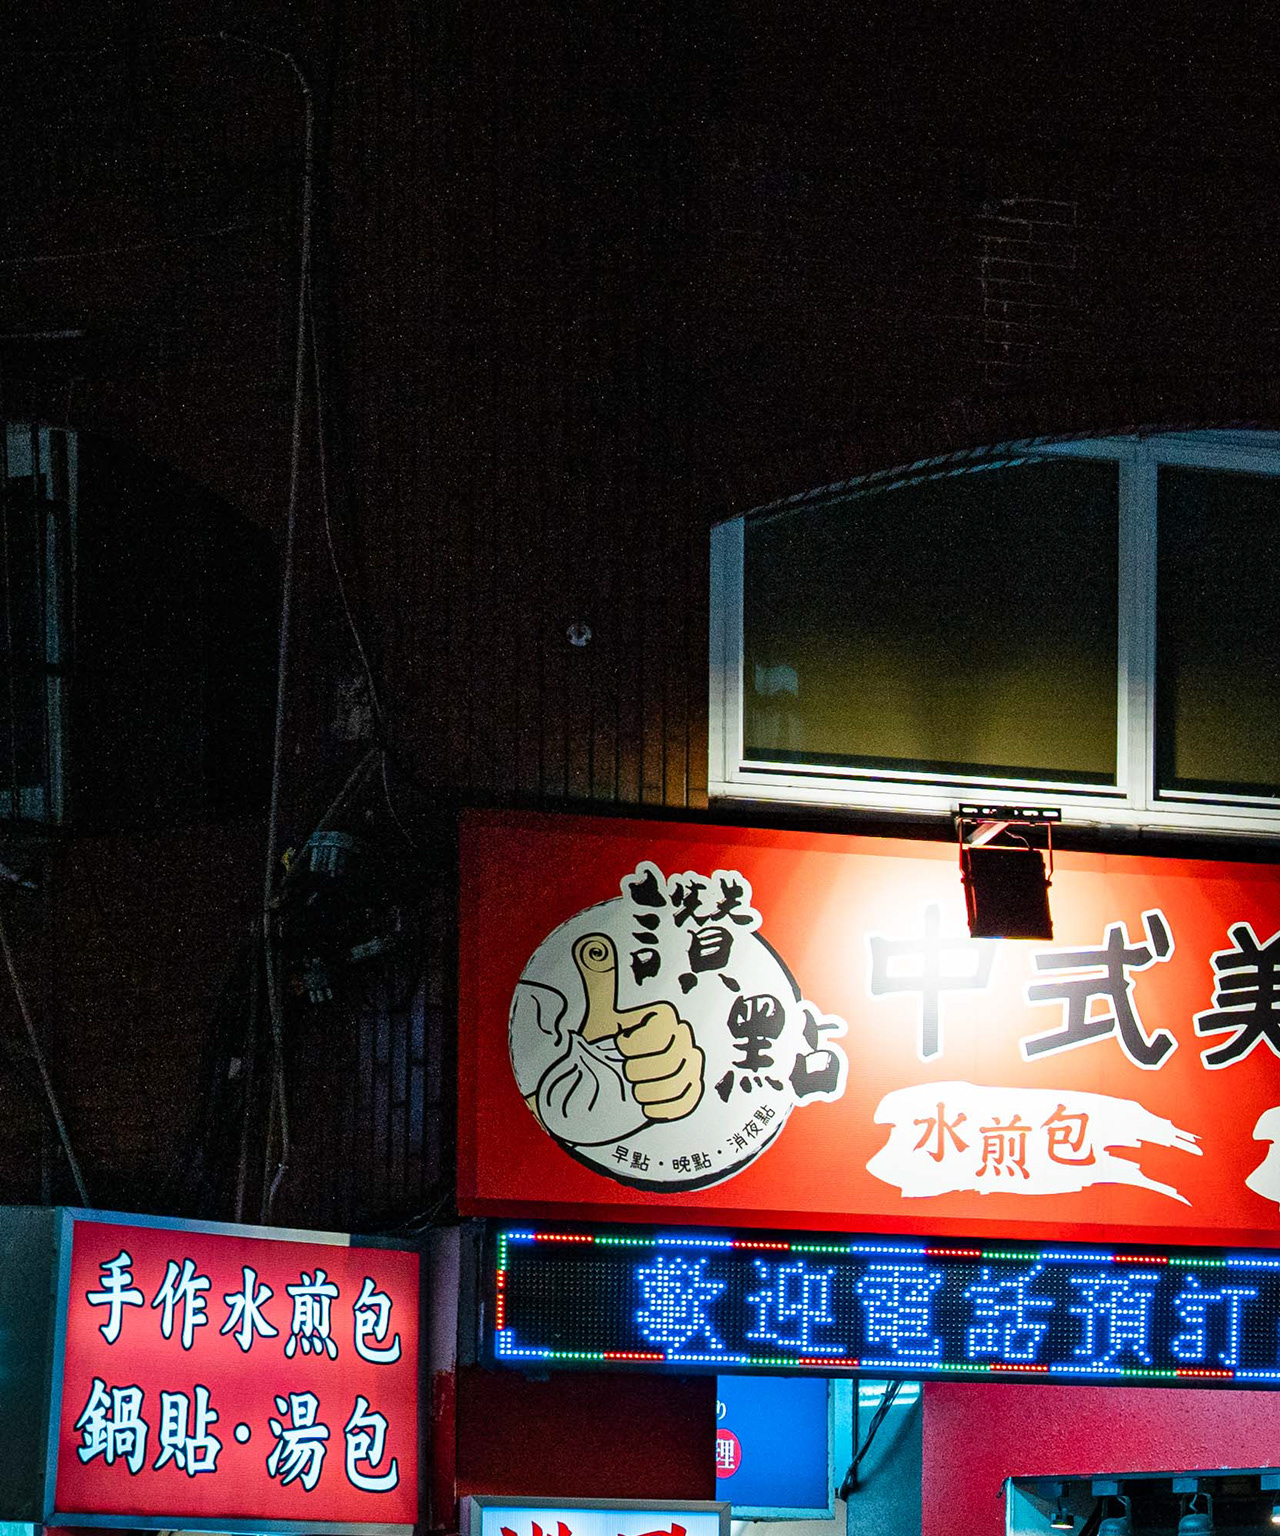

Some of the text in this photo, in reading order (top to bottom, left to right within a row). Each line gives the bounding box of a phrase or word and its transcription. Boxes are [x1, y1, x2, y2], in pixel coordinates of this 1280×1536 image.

[629, 867, 843, 1102] 讚點
[913, 1103, 1095, 1179] 水煎包
[88, 1252, 400, 1364] 手作水煎包
